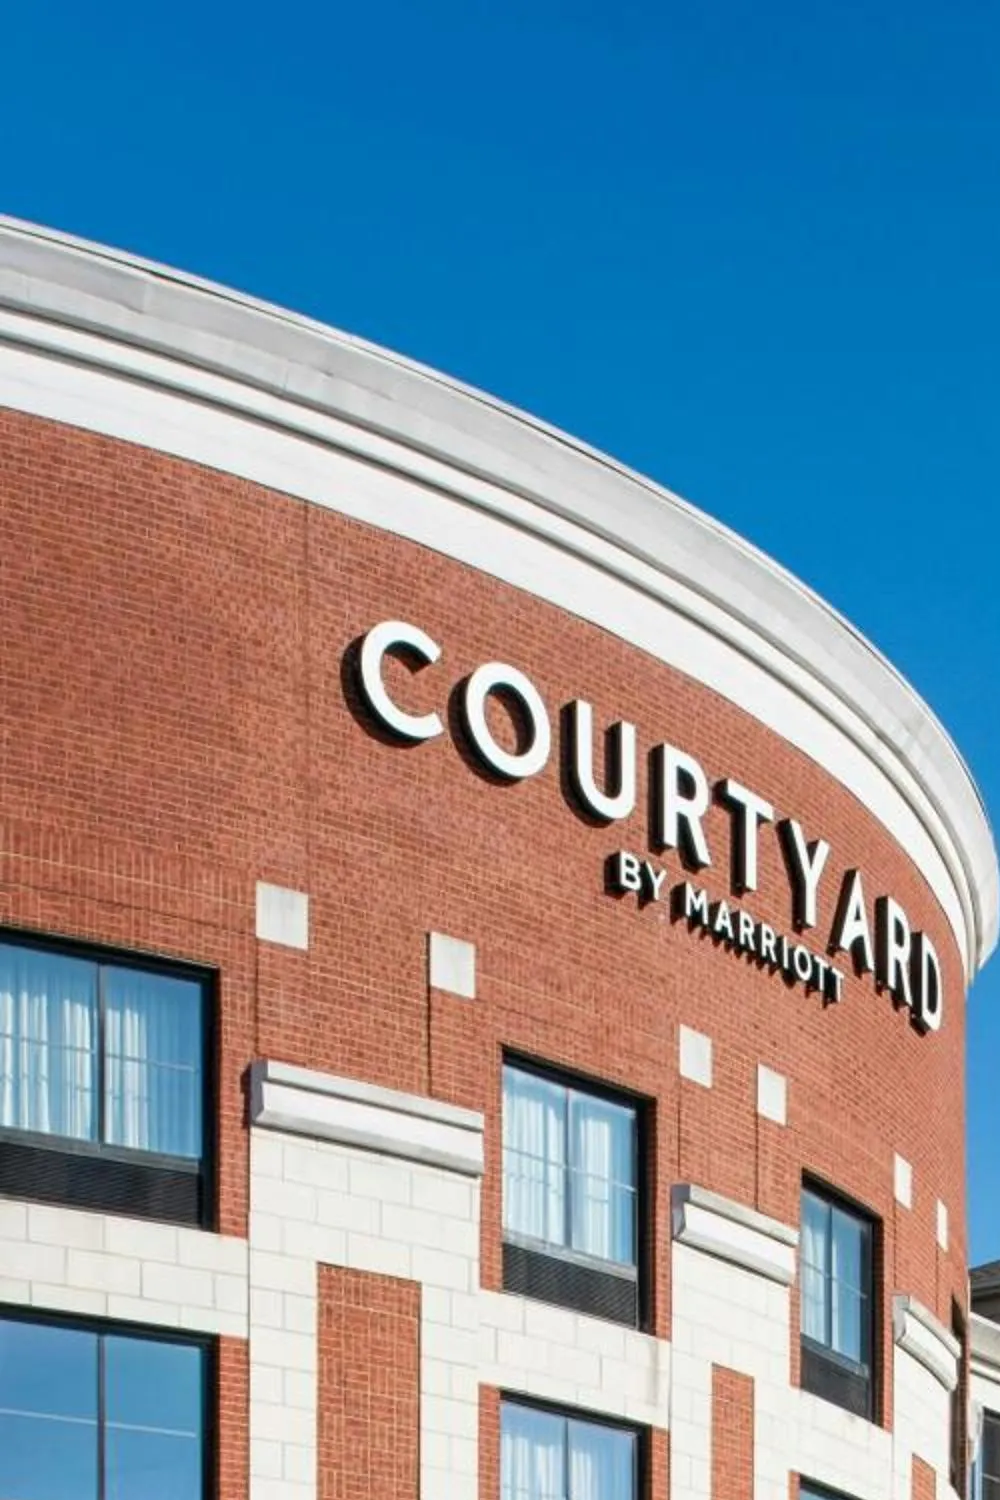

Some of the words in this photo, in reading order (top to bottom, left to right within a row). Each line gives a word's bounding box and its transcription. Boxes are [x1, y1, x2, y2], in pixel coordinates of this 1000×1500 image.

[357, 619, 943, 1032] COURTYARD
[616, 850, 667, 902] BY
[682, 881, 845, 1004] MARRIOTT
